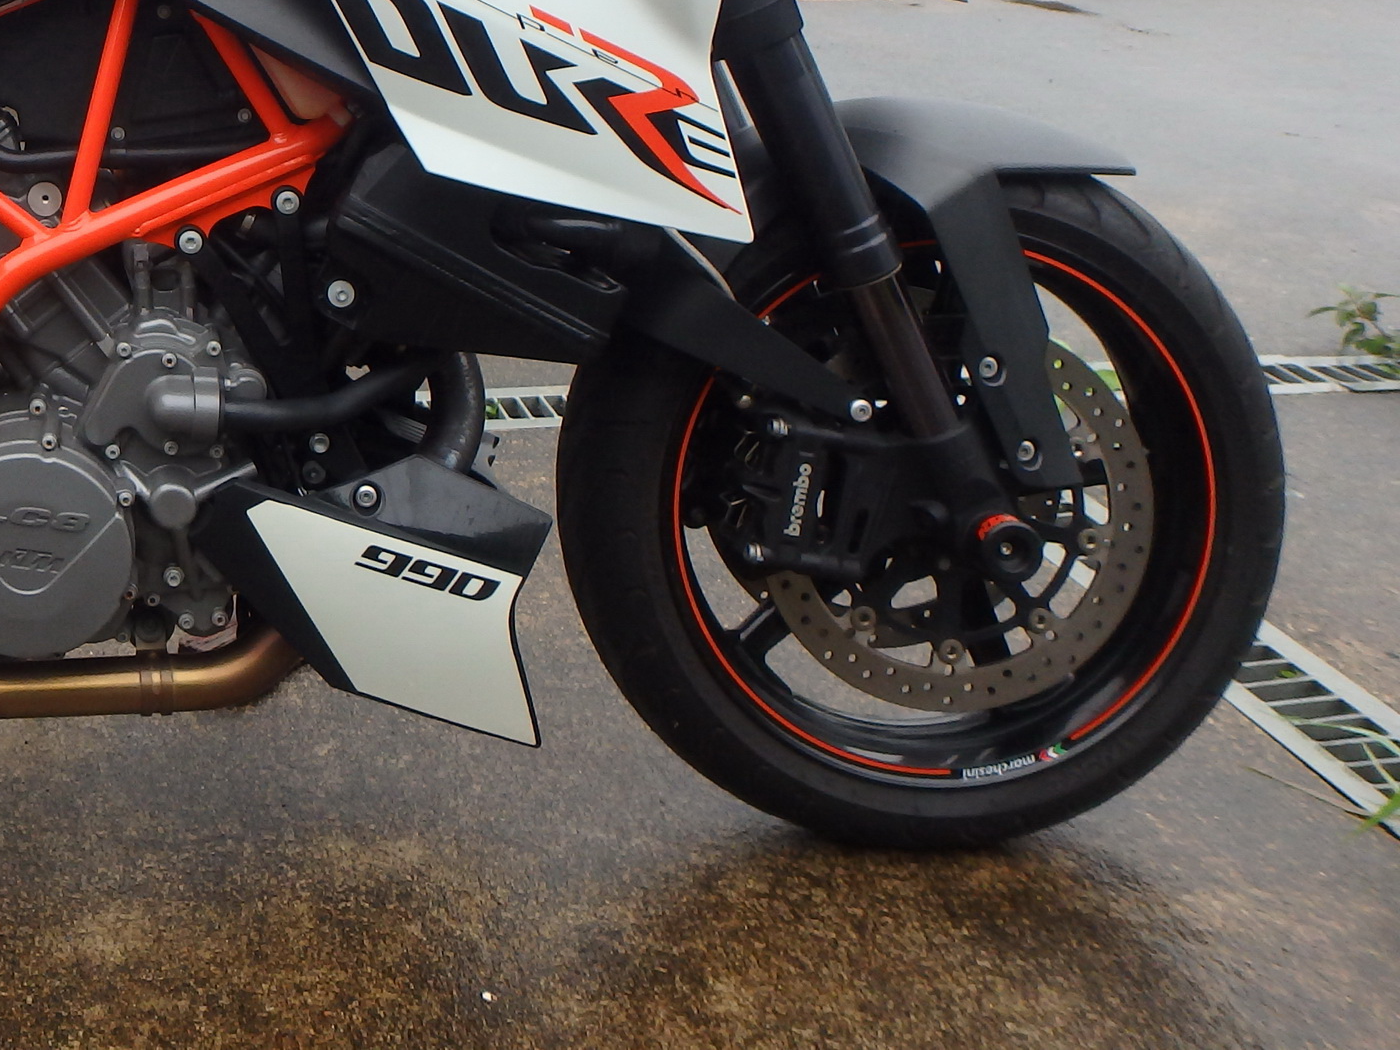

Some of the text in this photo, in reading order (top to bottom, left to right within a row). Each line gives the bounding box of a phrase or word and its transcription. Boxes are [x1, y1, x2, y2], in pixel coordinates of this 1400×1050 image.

[782, 462, 813, 537] brembo
[353, 544, 502, 602] 990
[961, 753, 1037, 781] marchesini
